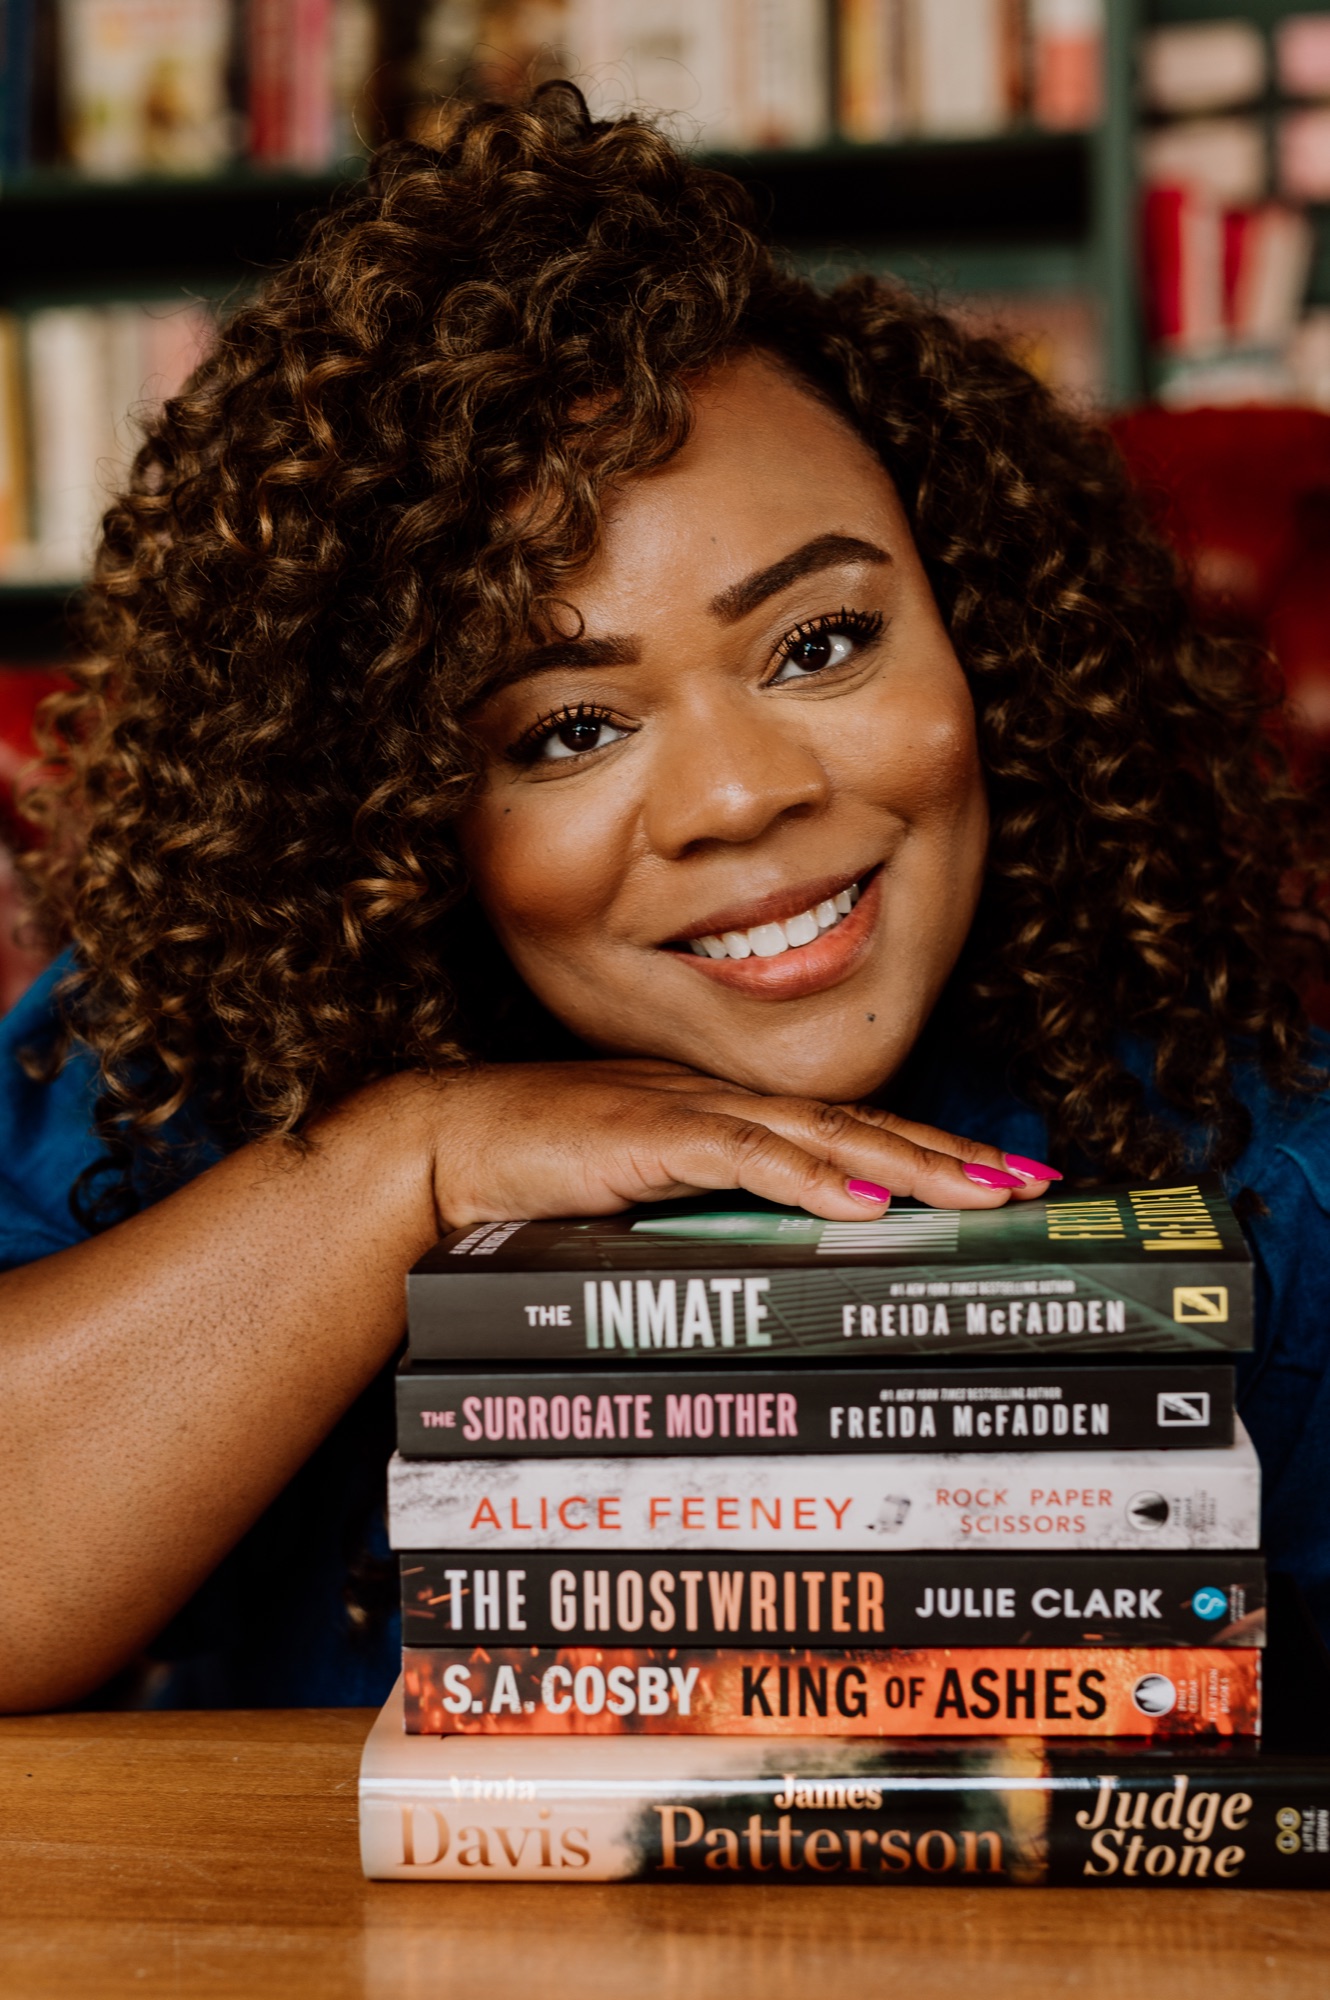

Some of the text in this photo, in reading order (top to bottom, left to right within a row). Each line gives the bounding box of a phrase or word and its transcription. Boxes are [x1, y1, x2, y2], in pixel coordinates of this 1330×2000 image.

[778, 1219, 814, 1232] THE
[1045, 1200, 1126, 1239] FREIDA
[524, 1278, 772, 1349] THE INMATE
[842, 1300, 1126, 1337] FREIDA McFADDEN
[420, 1393, 798, 1441] THE SURROGATE MOTHER
[830, 1404, 1109, 1438] FREIDA McFADDEN
[470, 1496, 853, 1530] ALICE FEENEY
[936, 1488, 1113, 1507] ROCK PAPER
[960, 1515, 1087, 1534] SCISSORS
[444, 1569, 885, 1632] THE GHOSTWRITER
[915, 1588, 1163, 1619] JULIE CLARK
[742, 1666, 1107, 1720] KING OF ASHES
[774, 1773, 883, 1810] James
[1075, 1774, 1253, 1842] Judge
[397, 1803, 592, 1868] Davis
[653, 1804, 1006, 1873] Patterson
[1317, 1809, 1329, 1853] BROWN
[1083, 1829, 1246, 1878] Stone
